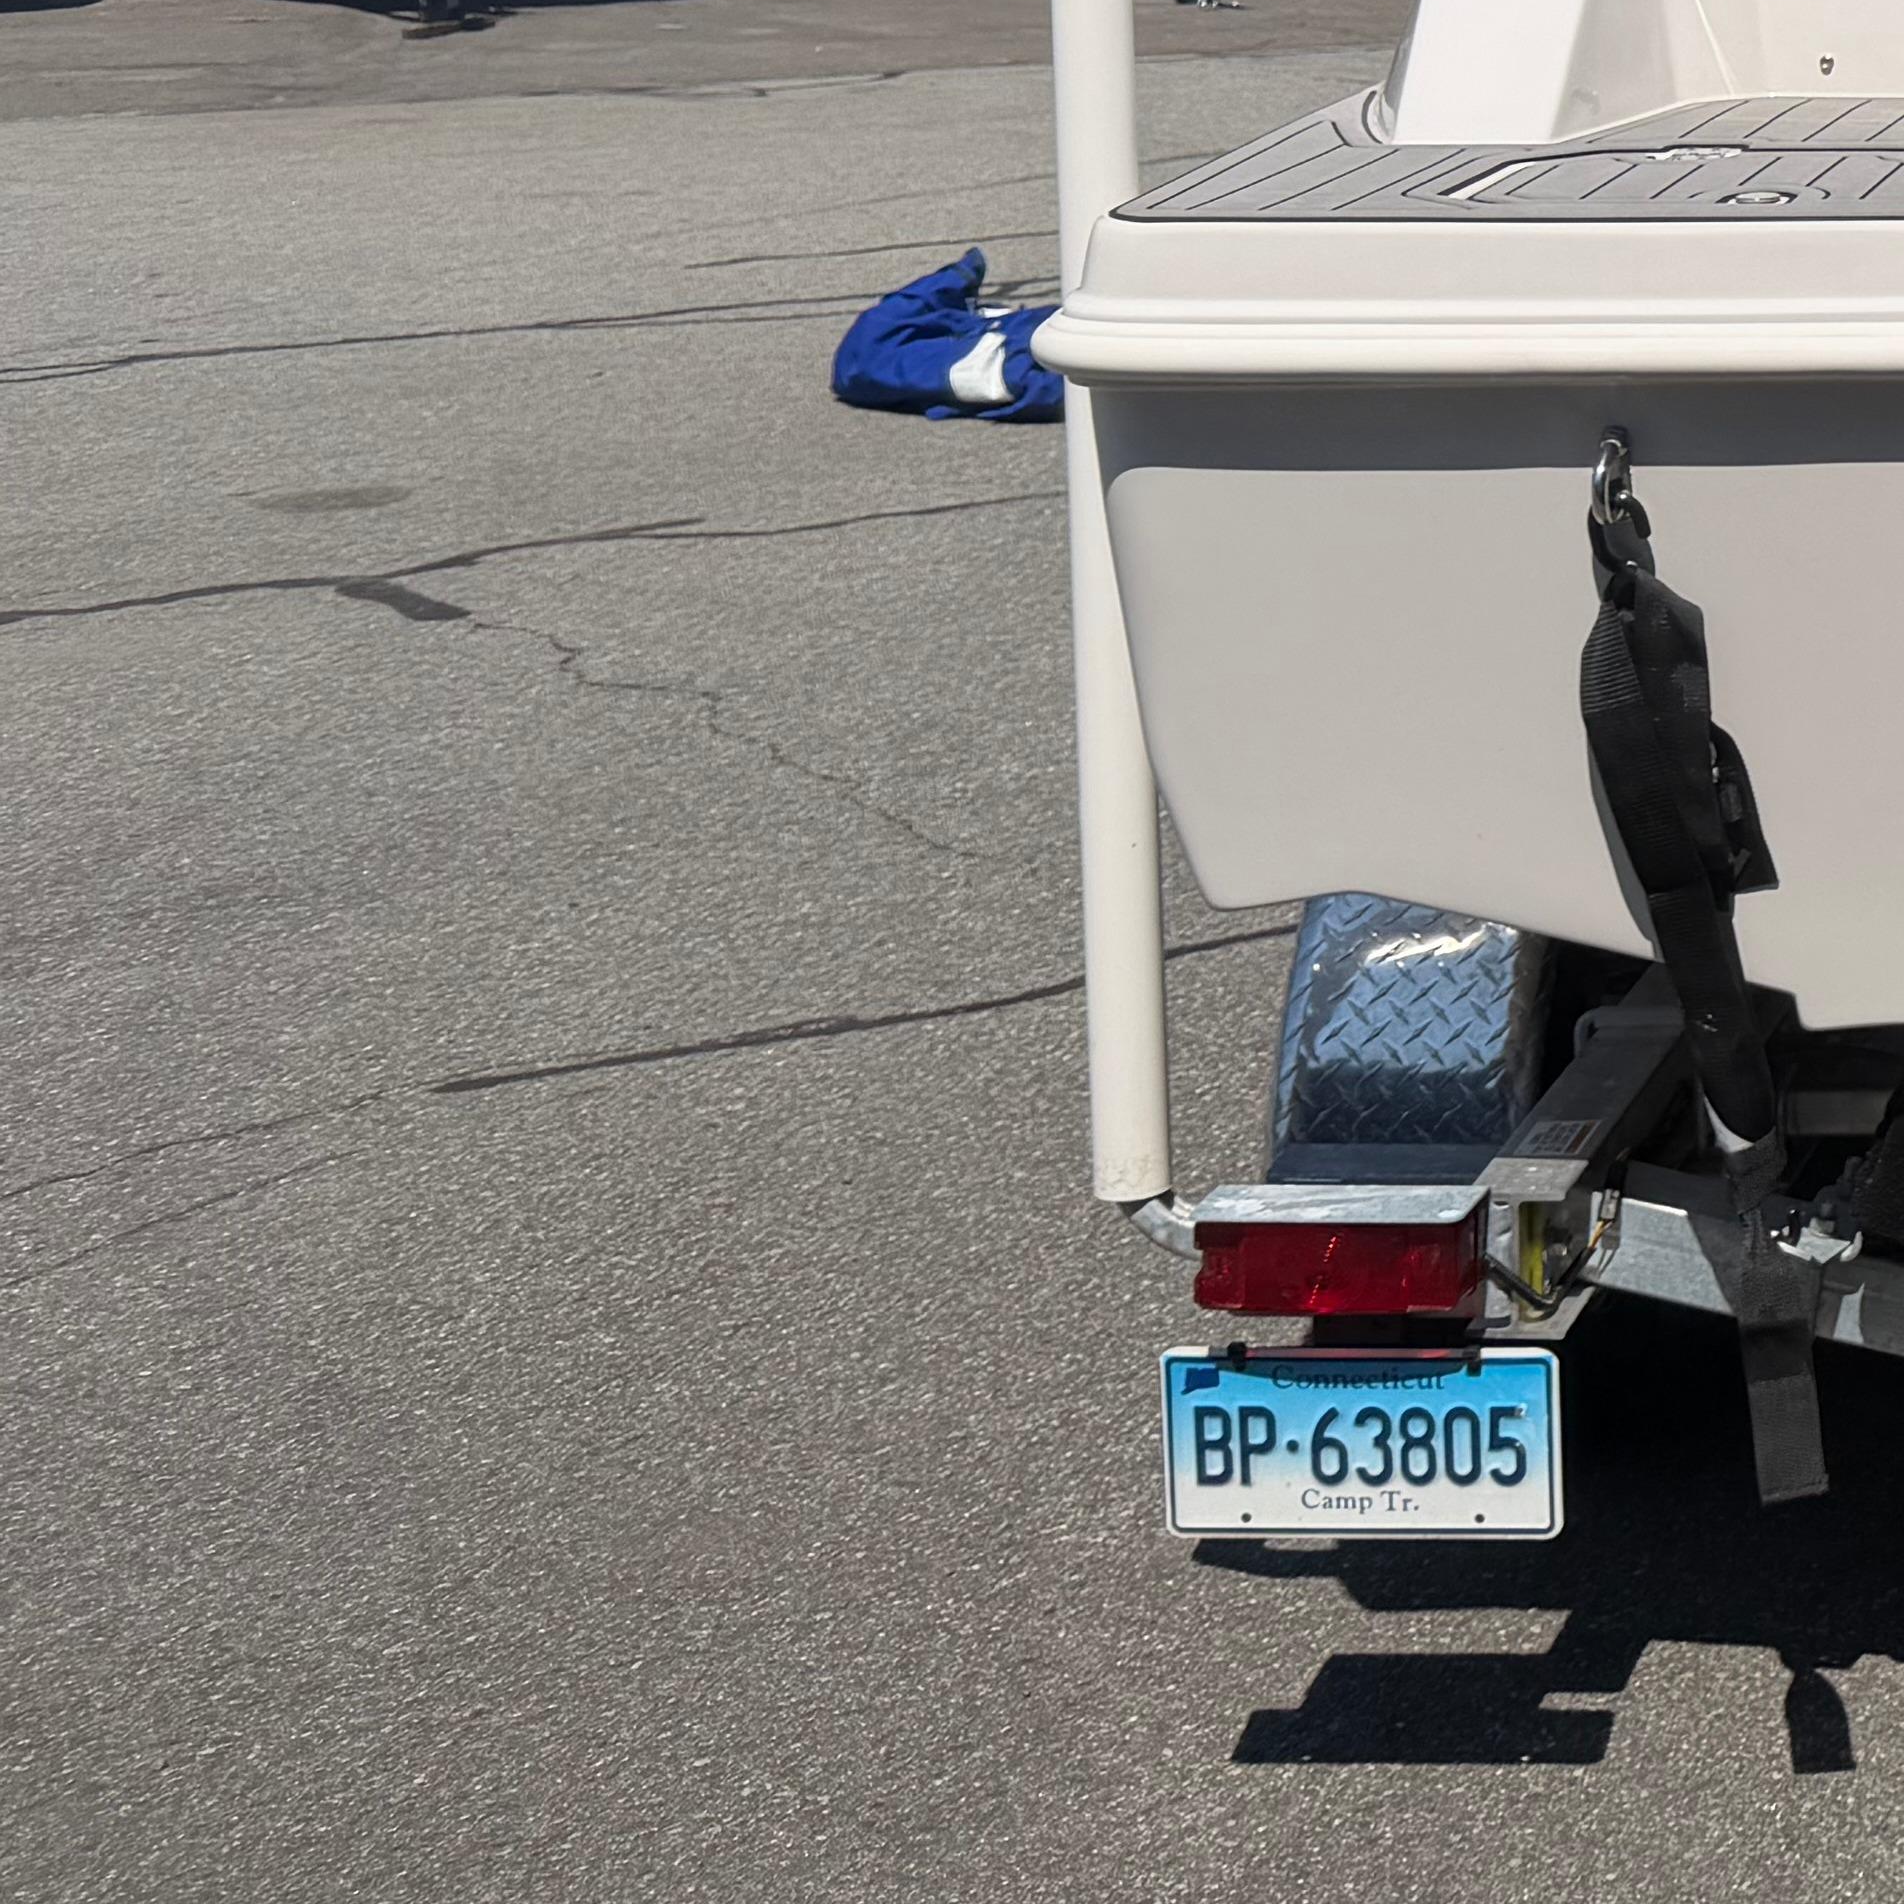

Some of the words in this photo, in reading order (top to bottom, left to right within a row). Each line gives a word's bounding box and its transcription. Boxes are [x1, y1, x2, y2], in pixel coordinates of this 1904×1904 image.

[1271, 1364, 1446, 1390] Connecticut
[1301, 1489, 1374, 1515] Camp
[1379, 1489, 1421, 1512] Tr.
